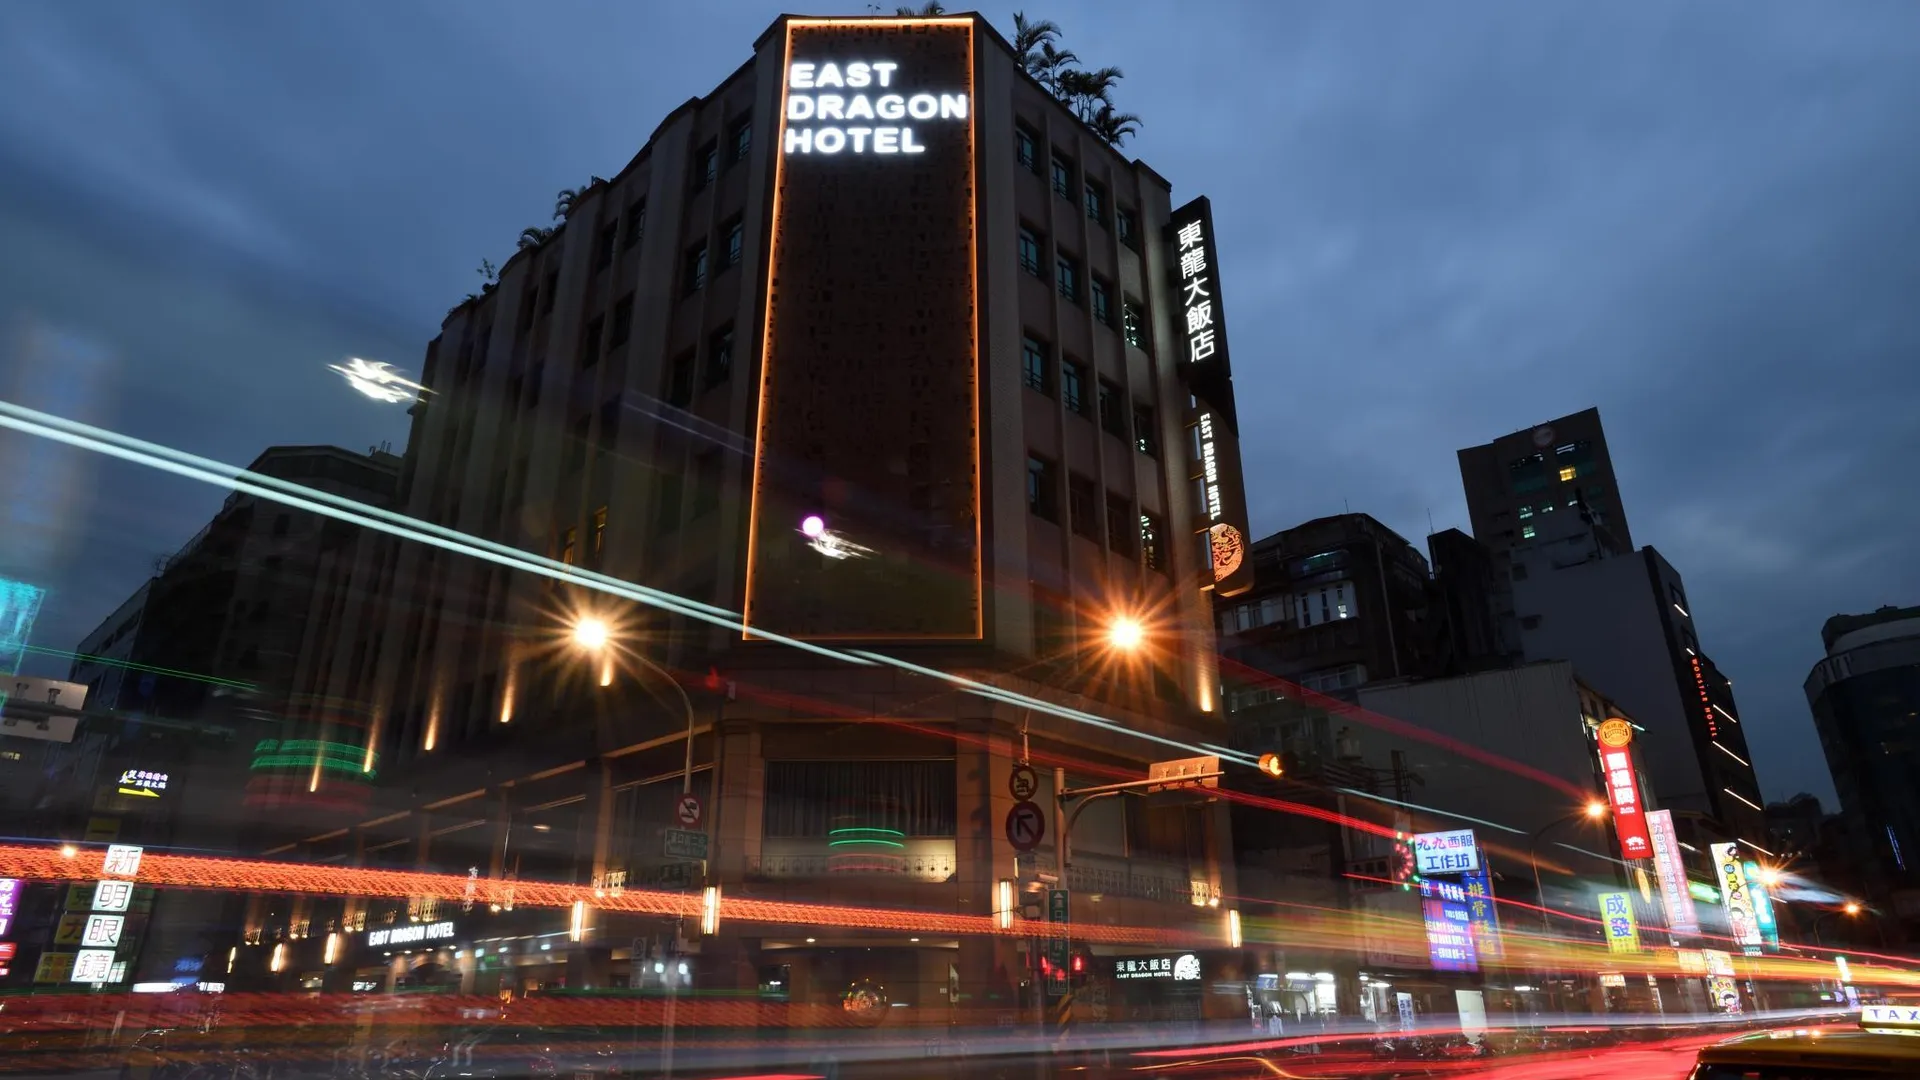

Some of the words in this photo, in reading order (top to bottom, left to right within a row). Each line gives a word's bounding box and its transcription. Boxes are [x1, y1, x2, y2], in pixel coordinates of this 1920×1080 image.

[790, 62, 898, 88] EAST
[786, 93, 968, 120] DRAGON
[784, 127, 926, 154] HOTEL
[1177, 219, 1215, 363] 東龍大飯店
[1200, 412, 1213, 440] EAST
[1203, 441, 1217, 483] DRAGON
[1207, 484, 1221, 521] HOTEL
[1704, 707, 1718, 737] HOTEL
[1417, 834, 1473, 850] 九九西服
[1426, 853, 1470, 870] 工作坊
[77, 849, 138, 979] 新明眼鏡
[1606, 894, 1632, 937] 成發
[369, 930, 390, 946] EAST
[390, 926, 425, 944] DRAGON
[426, 922, 454, 939] HOTEL
[1116, 958, 1171, 972] 東龍大飯店
